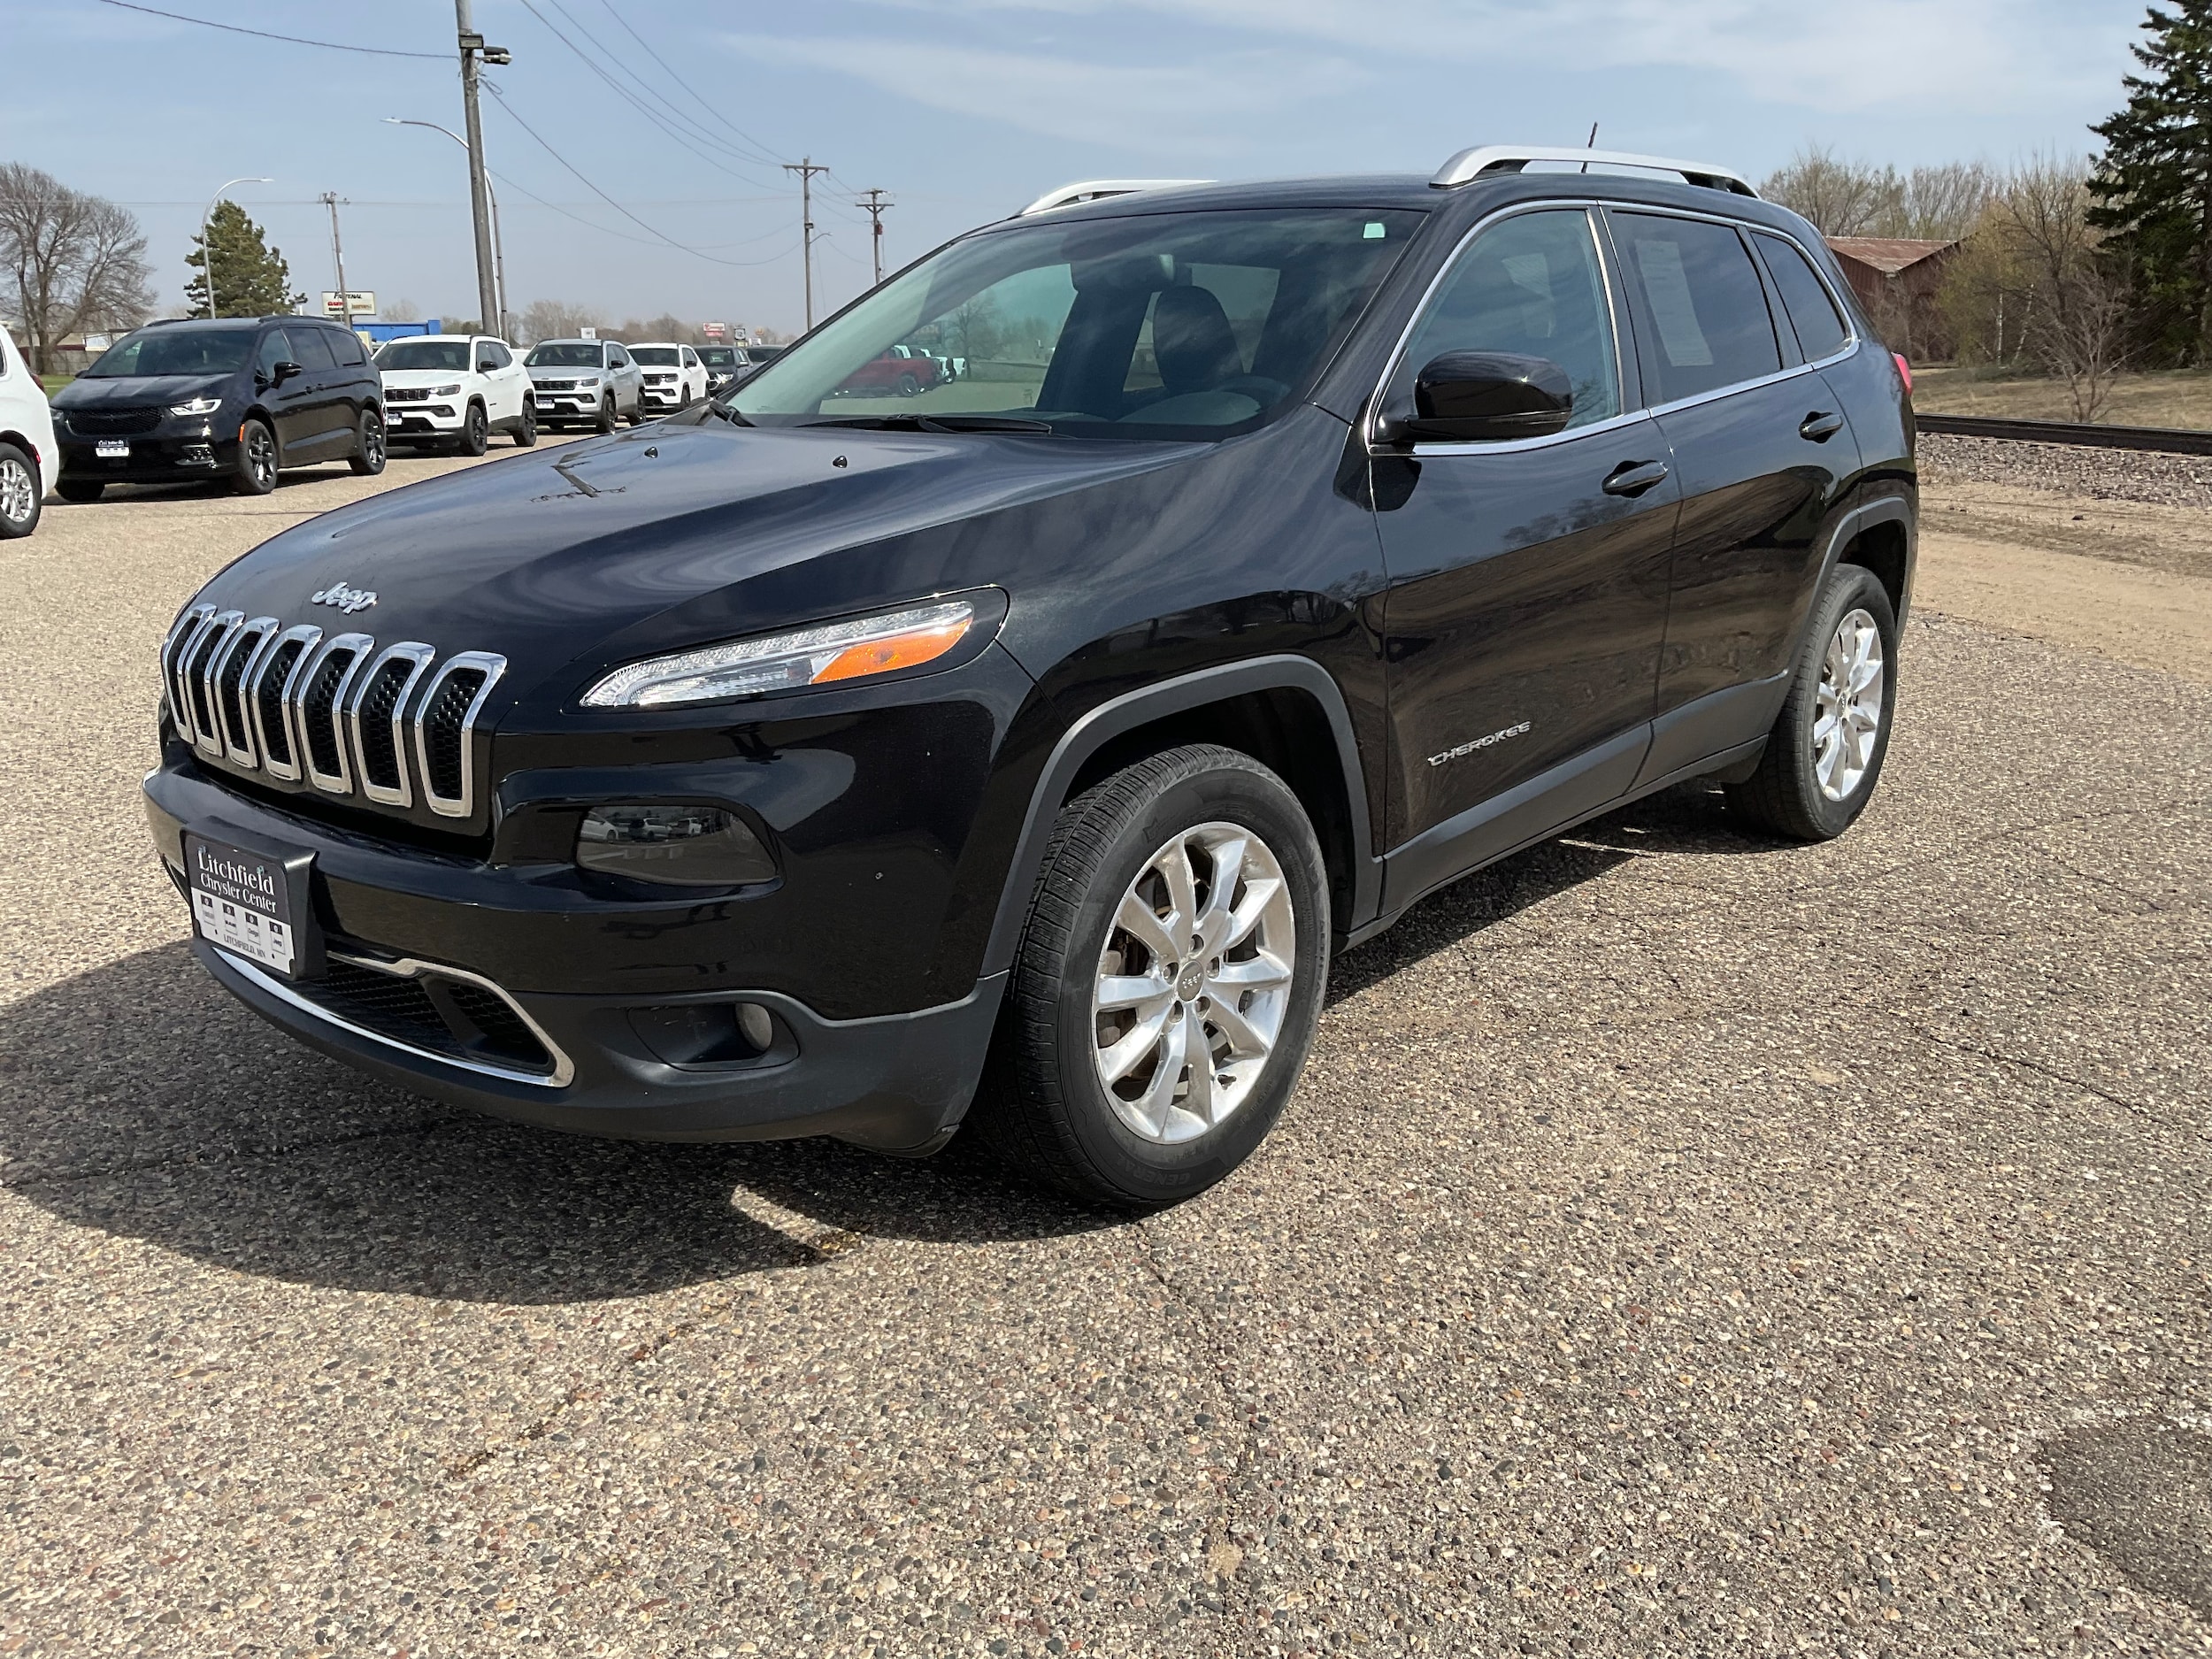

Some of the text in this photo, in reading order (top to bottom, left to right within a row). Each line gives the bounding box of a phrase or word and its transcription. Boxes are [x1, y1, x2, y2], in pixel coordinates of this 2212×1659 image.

[311, 581, 378, 614] Jeep
[1427, 720, 1532, 766] CHEROKEE
[198, 849, 275, 896] Litchfield
[201, 872, 277, 913] Chrysler Center
